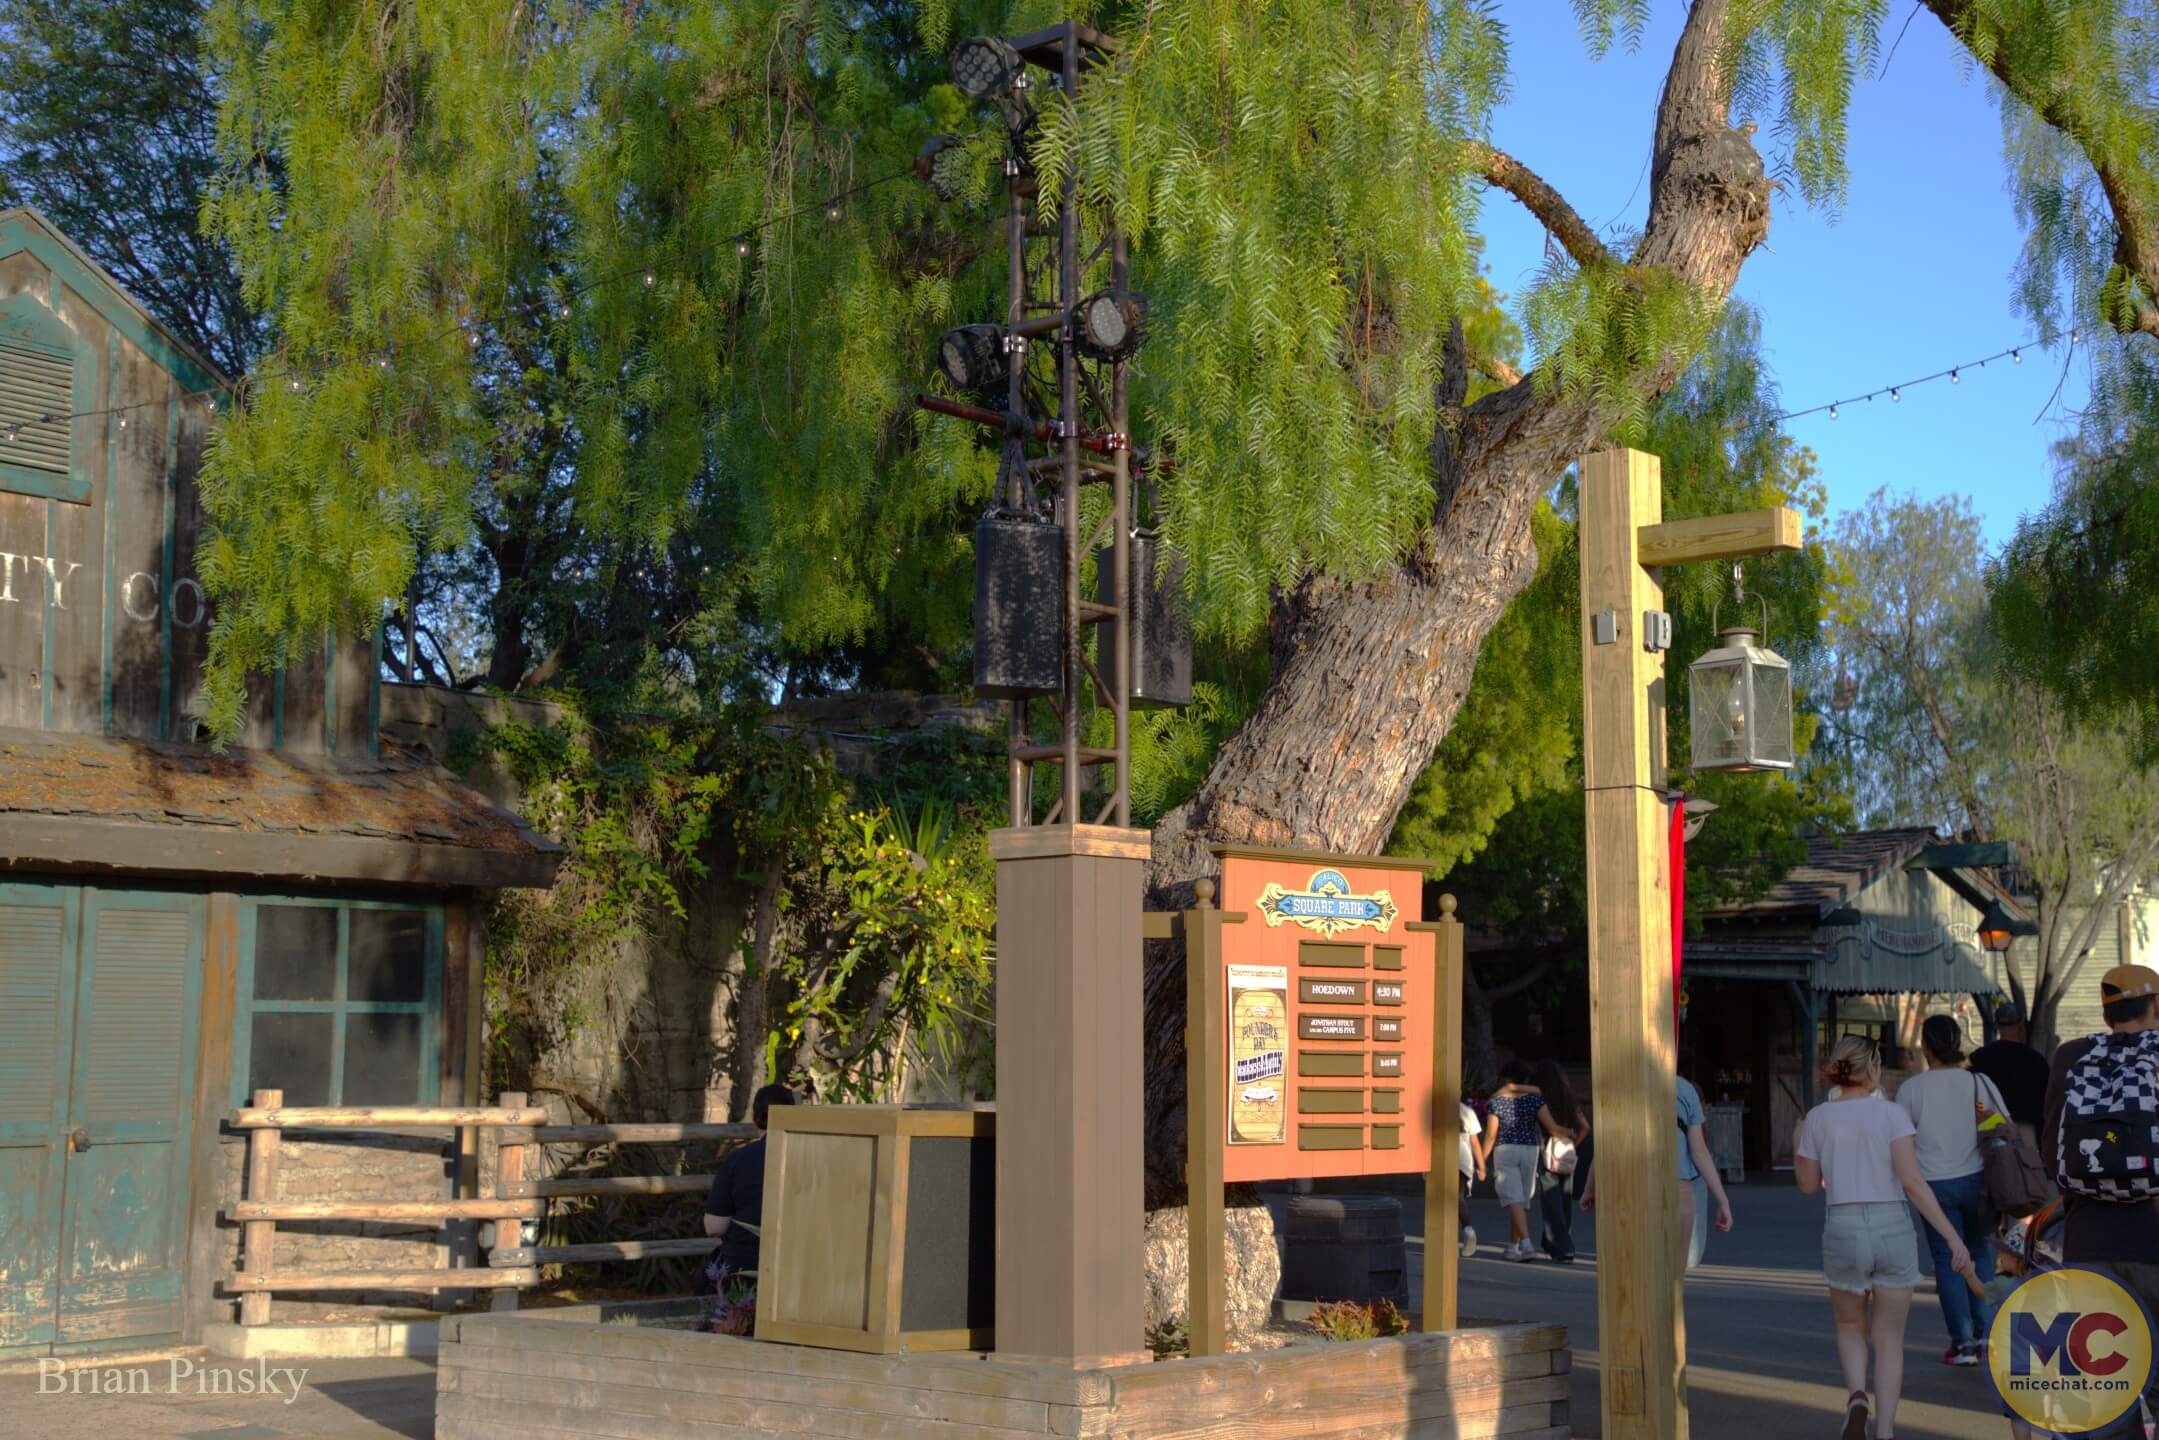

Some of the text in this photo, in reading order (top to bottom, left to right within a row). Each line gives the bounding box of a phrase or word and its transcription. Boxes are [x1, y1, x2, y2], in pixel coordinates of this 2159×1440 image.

[1293, 898, 1364, 915] SQUARE PARK
[1311, 984, 1355, 996] HOEDOWN
[1391, 987, 1401, 998] PM
[1390, 1023, 1397, 1032] PM
[1253, 1036, 1266, 1051] DAY
[1236, 1051, 1283, 1082] CELEBRATION
